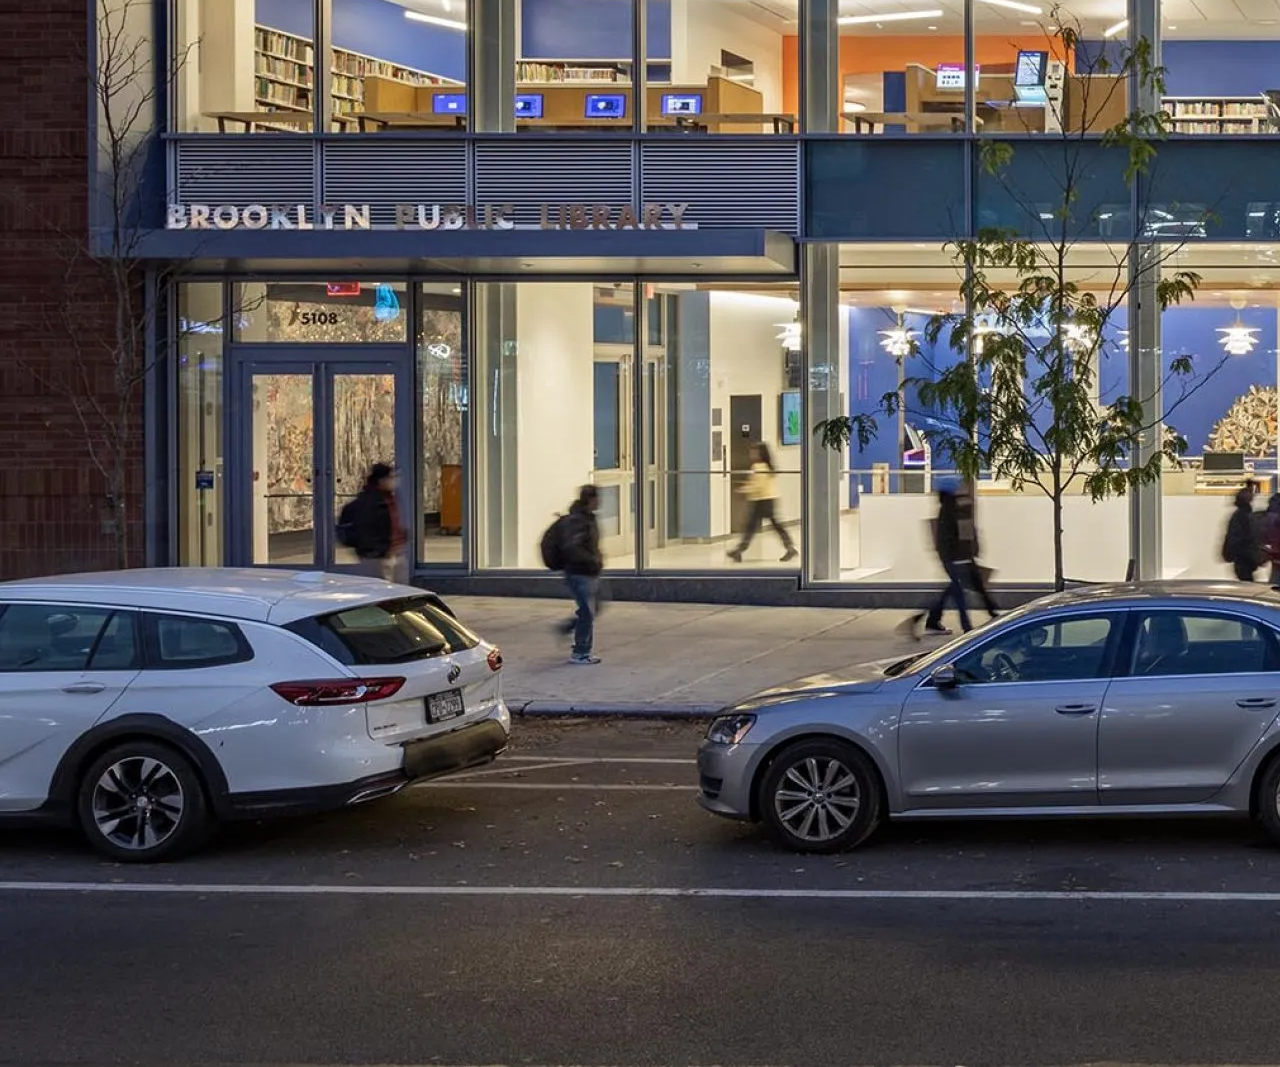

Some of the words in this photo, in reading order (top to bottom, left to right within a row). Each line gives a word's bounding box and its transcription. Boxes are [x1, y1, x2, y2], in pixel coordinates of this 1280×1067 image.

[167, 203, 371, 230] BROOKLYN
[395, 203, 514, 230] PUBLIC
[540, 203, 689, 230] LIBRARY
[301, 312, 338, 325] 5108
